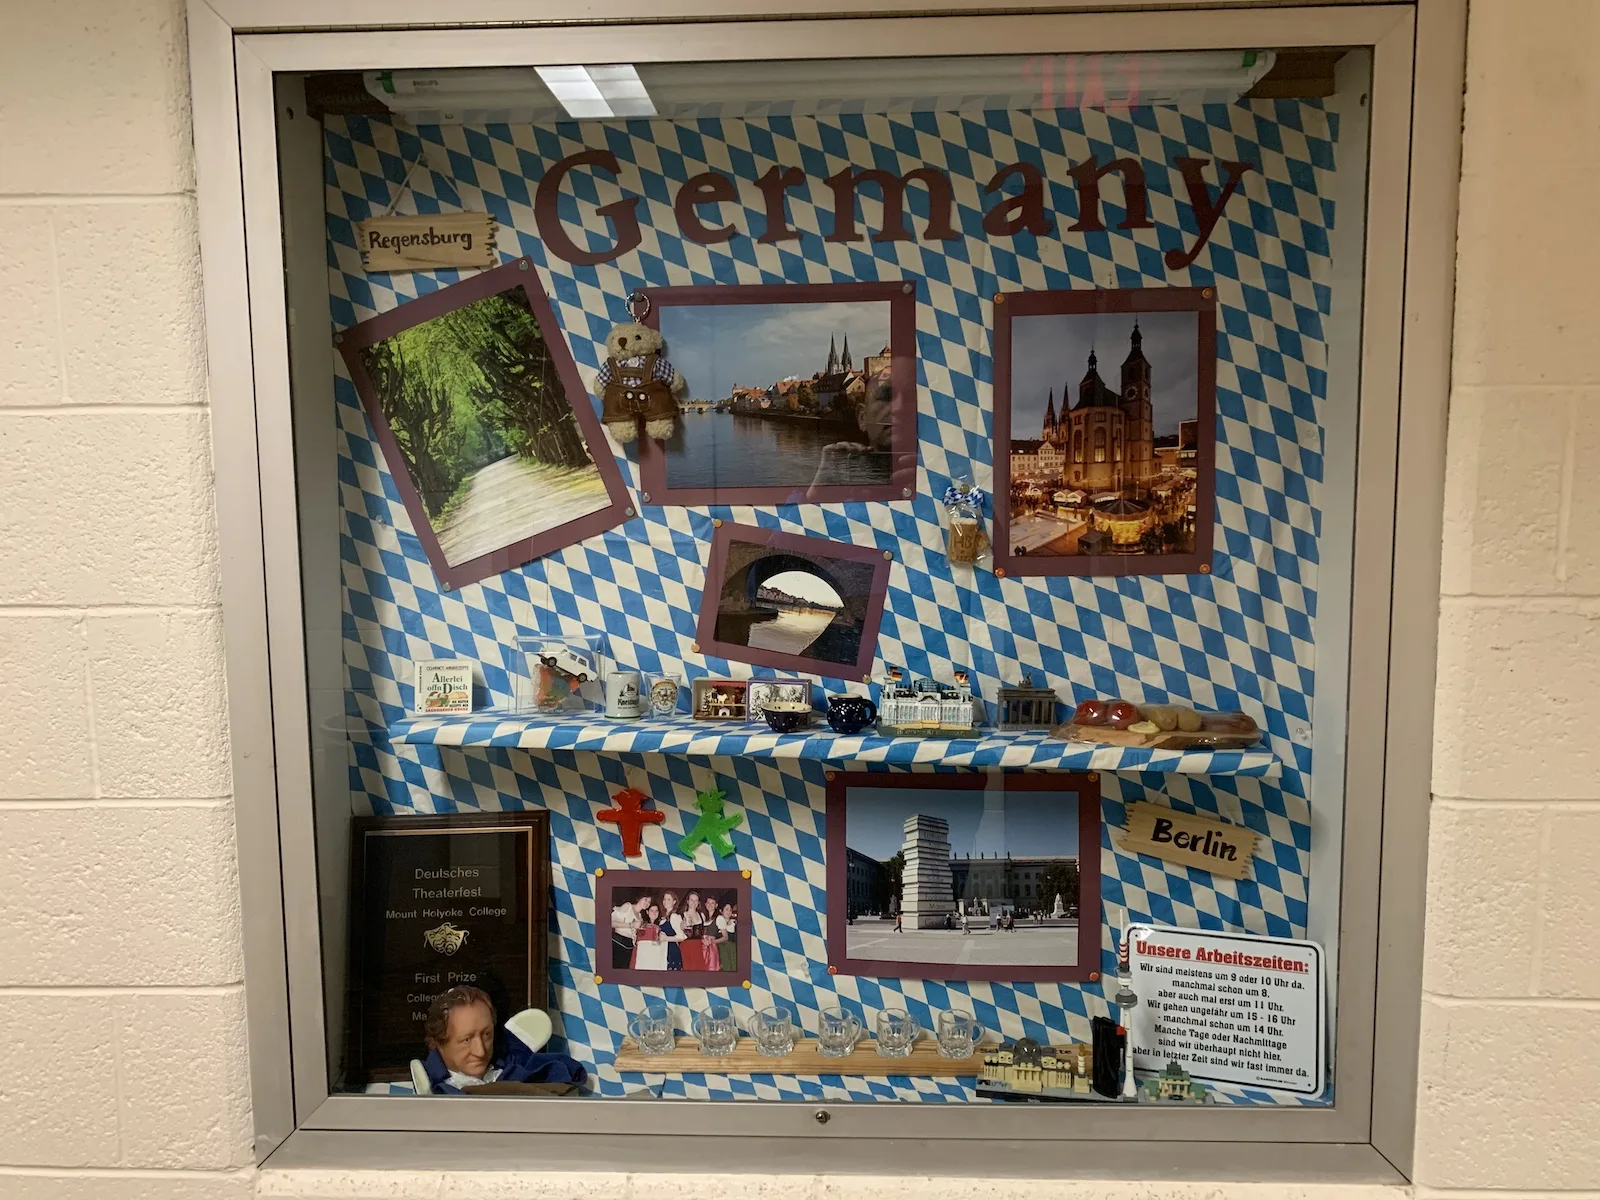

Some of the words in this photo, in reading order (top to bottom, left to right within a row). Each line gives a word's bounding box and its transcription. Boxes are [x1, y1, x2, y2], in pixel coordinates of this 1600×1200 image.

[533, 149, 1254, 272] Germany
[368, 226, 472, 254] Regensburg
[432, 672, 463, 683] Allerlei
[443, 683, 468, 695] Disch
[1151, 817, 1237, 861] Berlin
[415, 867, 480, 880] Deutsches
[412, 886, 482, 899] Theaterfest
[386, 910, 417, 919] Mount
[422, 908, 464, 919] Holyoke
[469, 906, 507, 917] College
[1136, 940, 1191, 959] Unsere
[1196, 947, 1309, 973] Arbeitszeiten:
[415, 972, 440, 984] First
[447, 971, 477, 983] Prize
[1140, 962, 1153, 972] Wir
[1156, 964, 1173, 974] sind
[1175, 966, 1213, 979] meistens
[1215, 972, 1228, 980] um
[1231, 973, 1237, 982] 9
[1239, 975, 1257, 984] oder
[1261, 976, 1271, 986] 10
[1274, 977, 1289, 988] Uhr
[1291, 980, 1305, 990] da.
[406, 993, 438, 1004] Colleg
[1158, 989, 1176, 999] aber
[1178, 991, 1199, 1001] auch
[1201, 995, 1217, 1003] mal
[1219, 997, 1235, 1006] erst
[1238, 1000, 1251, 1008] um
[1255, 1000, 1264, 1009] 11
[1268, 1001, 1284, 1012] Uhr.
[1172, 980, 1216, 992] manchmal
[1218, 984, 1243, 995] schon
[1245, 988, 1259, 996] um
[1261, 988, 1270, 998] 8.
[1147, 999, 1161, 1009] Wir
[1163, 1002, 1188, 1012] gehen
[1190, 1005, 1228, 1017] ungefähr
[1230, 1010, 1244, 1019] um
[1247, 1011, 1258, 1021] 15
[1268, 1014, 1278, 1023] 16
[1281, 1015, 1296, 1026] Uhr
[1154, 1024, 1187, 1036] Manche
[1189, 1029, 1209, 1040] Tage
[1212, 1032, 1230, 1042] oder
[1233, 1034, 1287, 1050] Nachmittage
[1163, 1015, 1207, 1027] manchmal
[1209, 1020, 1234, 1030] schon
[1237, 1024, 1251, 1032] um
[1254, 1025, 1264, 1034] 14
[1267, 1026, 1284, 1037] Uhr.
[1158, 1038, 1176, 1047] sind
[1178, 1040, 1191, 1049] wir
[1194, 1042, 1236, 1056] überhaupt
[1239, 1048, 1261, 1058] nicht
[1264, 1050, 1282, 1061] hier.
[1132, 1046, 1150, 1055] aber
[1153, 1048, 1160, 1057] in
[1163, 1050, 1189, 1061] letzter
[1192, 1053, 1208, 1063] Zeit
[1210, 1057, 1228, 1066] sind
[1231, 1059, 1244, 1069] wir
[1247, 1060, 1263, 1071] fast
[1265, 1063, 1293, 1075] immer
[1296, 1067, 1309, 1077] da.
